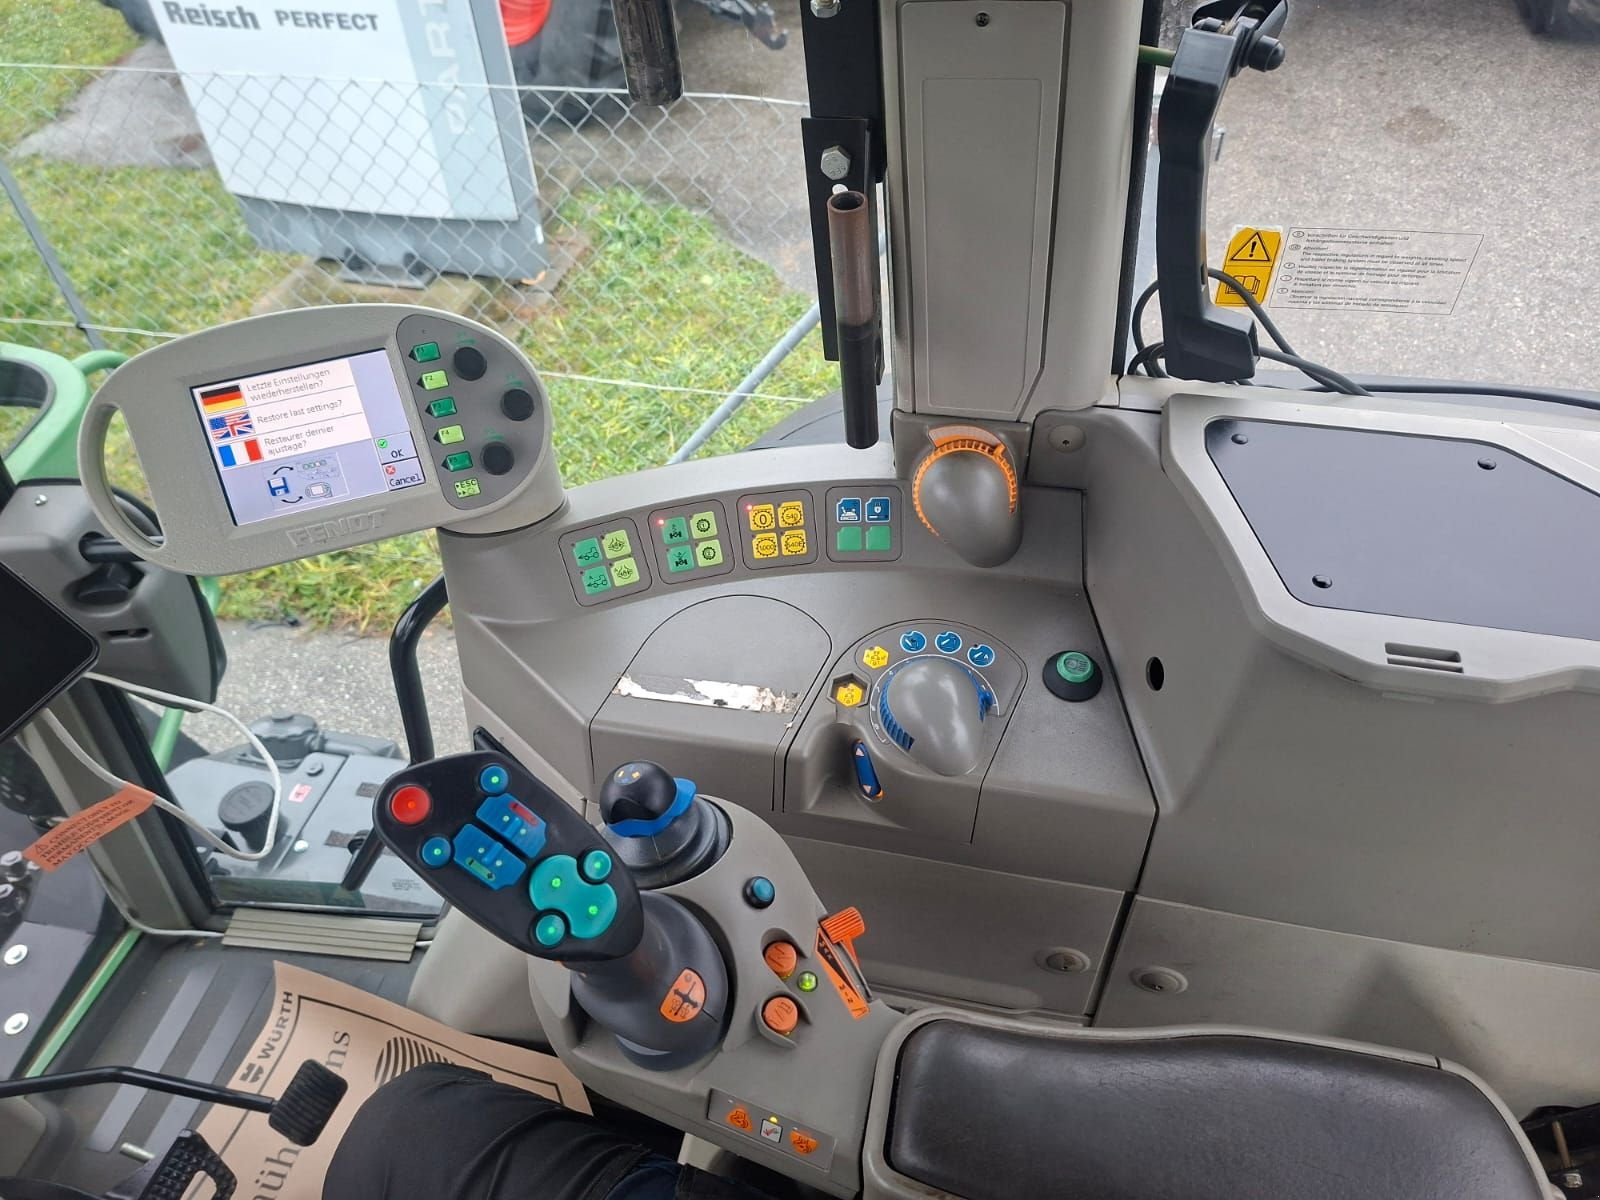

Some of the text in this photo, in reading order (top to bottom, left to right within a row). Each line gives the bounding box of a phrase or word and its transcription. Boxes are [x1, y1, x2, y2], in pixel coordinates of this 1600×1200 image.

[161, 0, 379, 32] Reisch PERFECT
[246, 369, 330, 393] Letzte Einstellungen
[250, 380, 324, 402] wiederherstellen?
[256, 399, 342, 424] Restore last settings?
[264, 424, 335, 446] Restaurer dernier
[390, 449, 403, 459] OK
[389, 473, 420, 488] Cancel
[460, 478, 477, 488] ESC
[286, 508, 386, 548] FENDT
[257, 991, 294, 1060] WÜRTH
